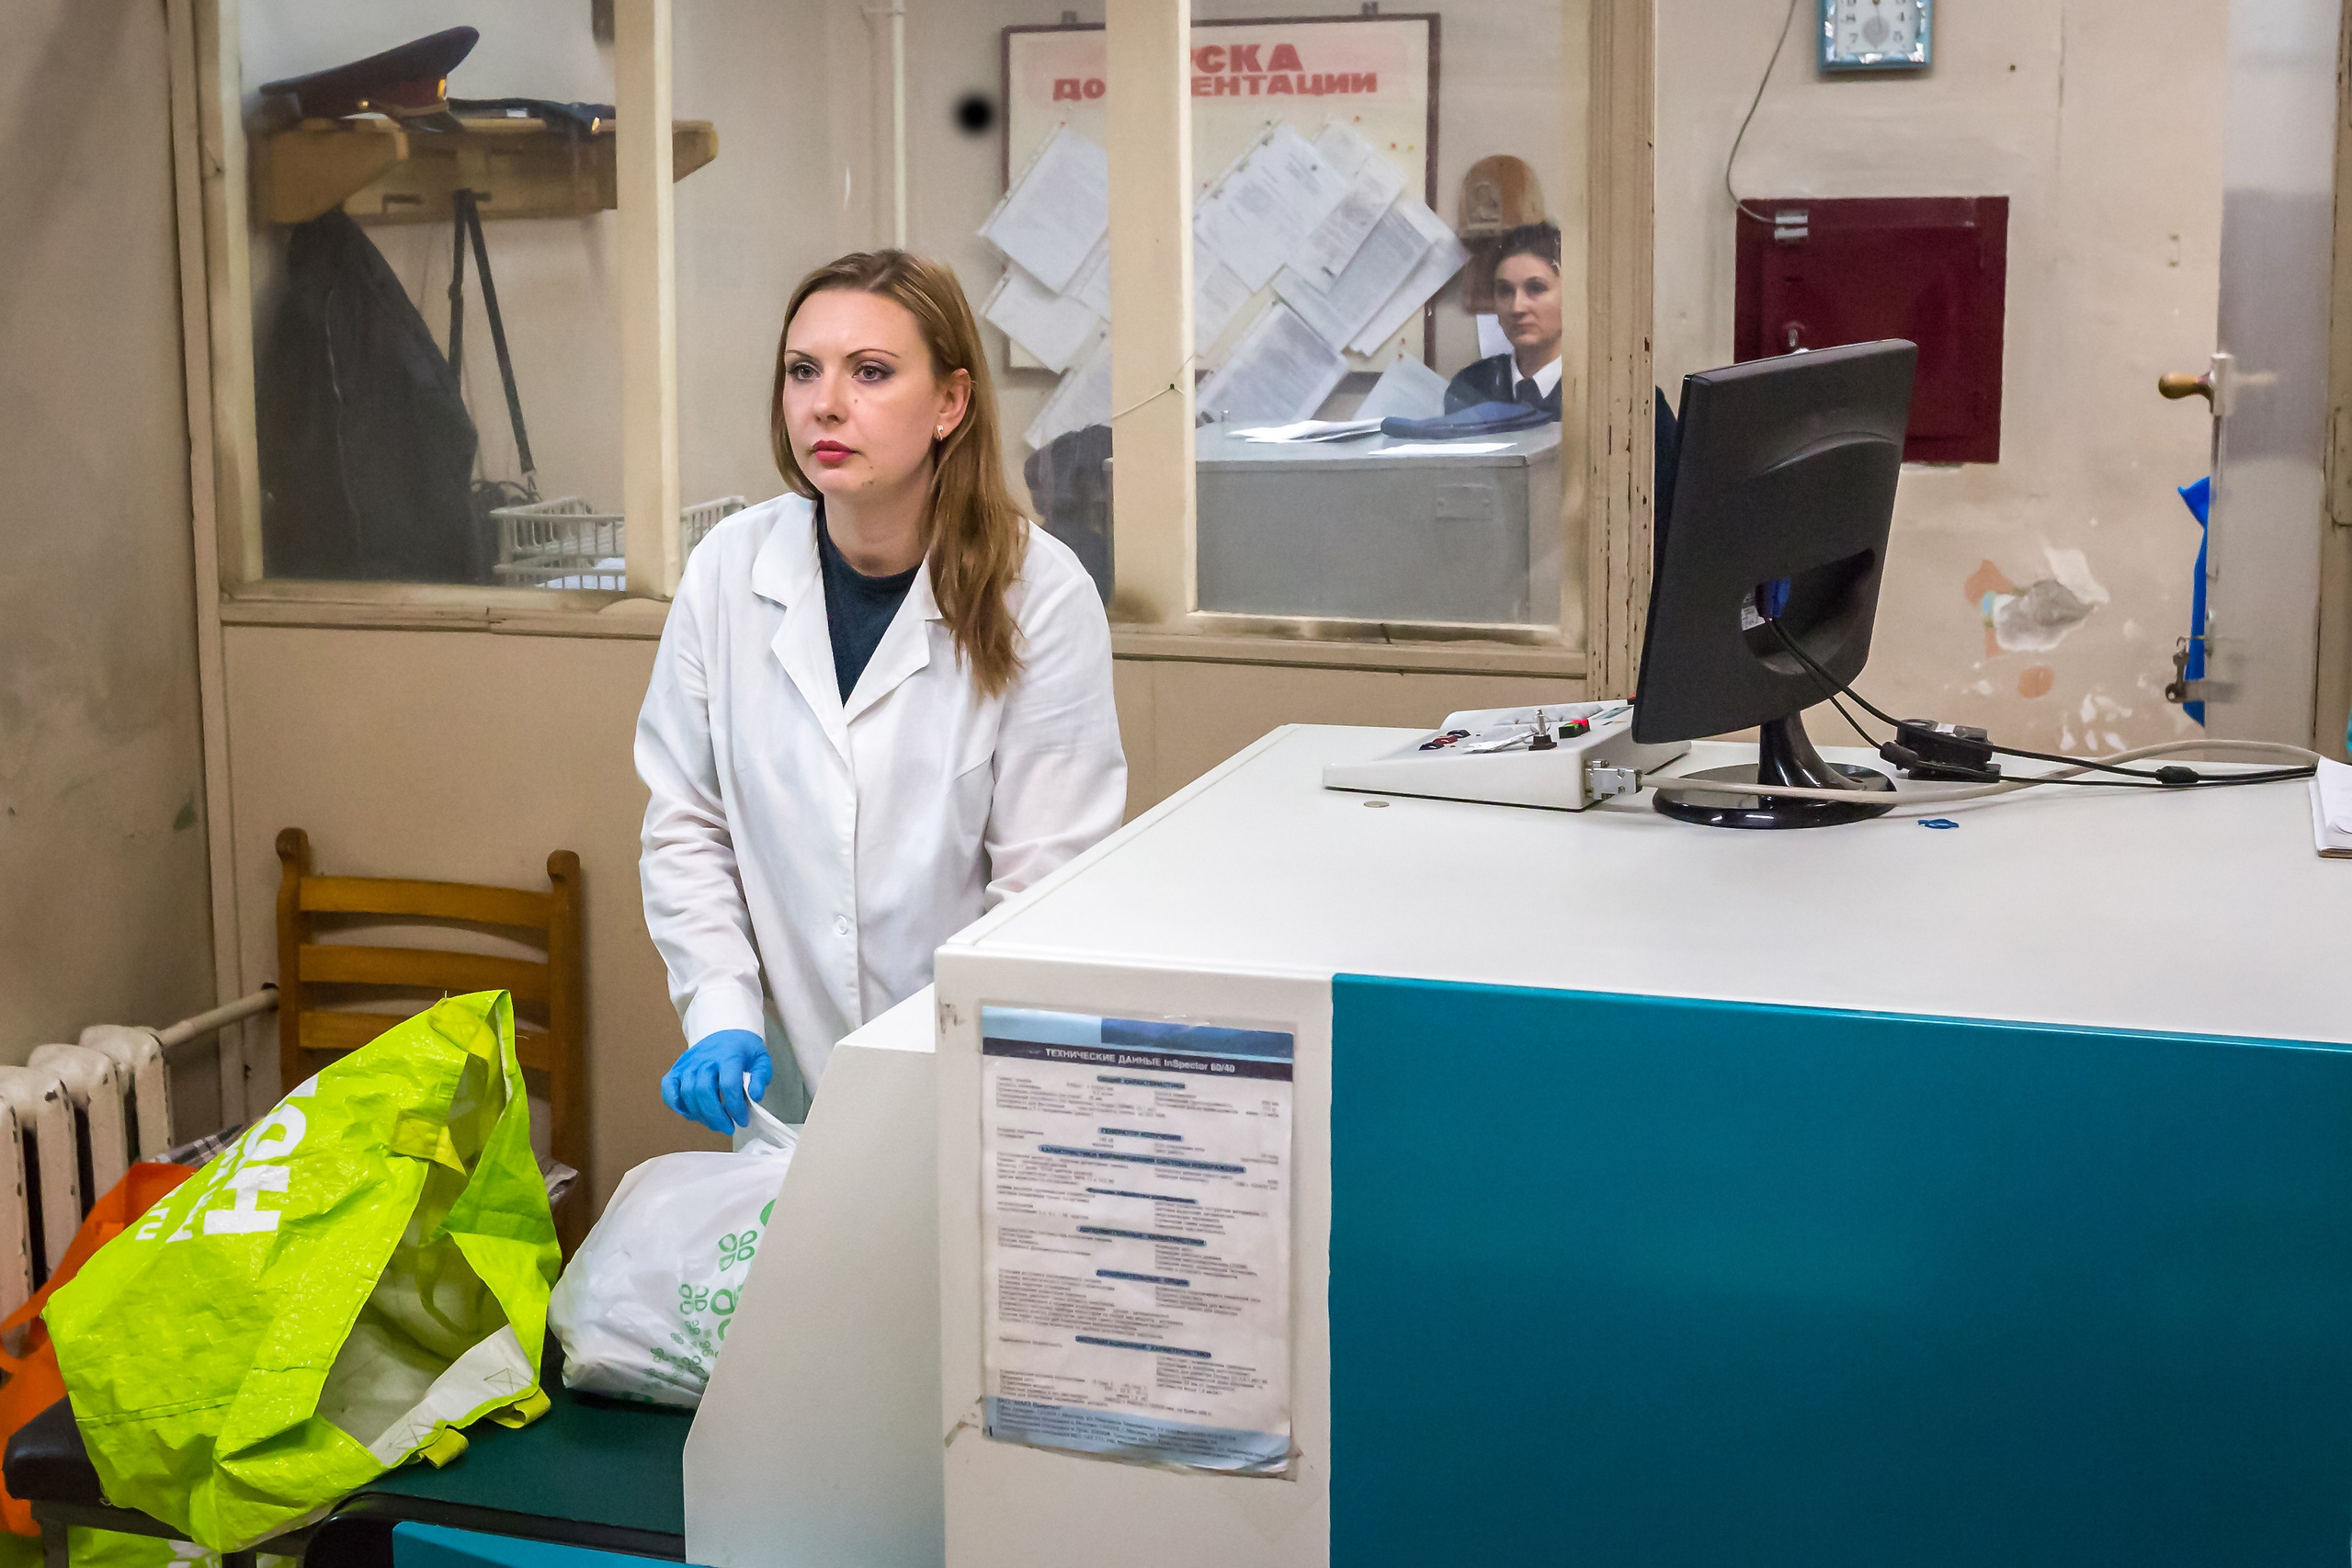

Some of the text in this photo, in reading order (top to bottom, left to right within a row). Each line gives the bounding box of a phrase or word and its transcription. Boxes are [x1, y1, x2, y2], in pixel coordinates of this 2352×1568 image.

[1189, 43, 1303, 74] СКА
[1052, 73, 1378, 102] ДОЕНТАЦИИ
[1045, 1048, 1116, 1062] ТЕХНИЧЕСКИЕ
[1118, 1054, 1162, 1067] ДАННЫЕ
